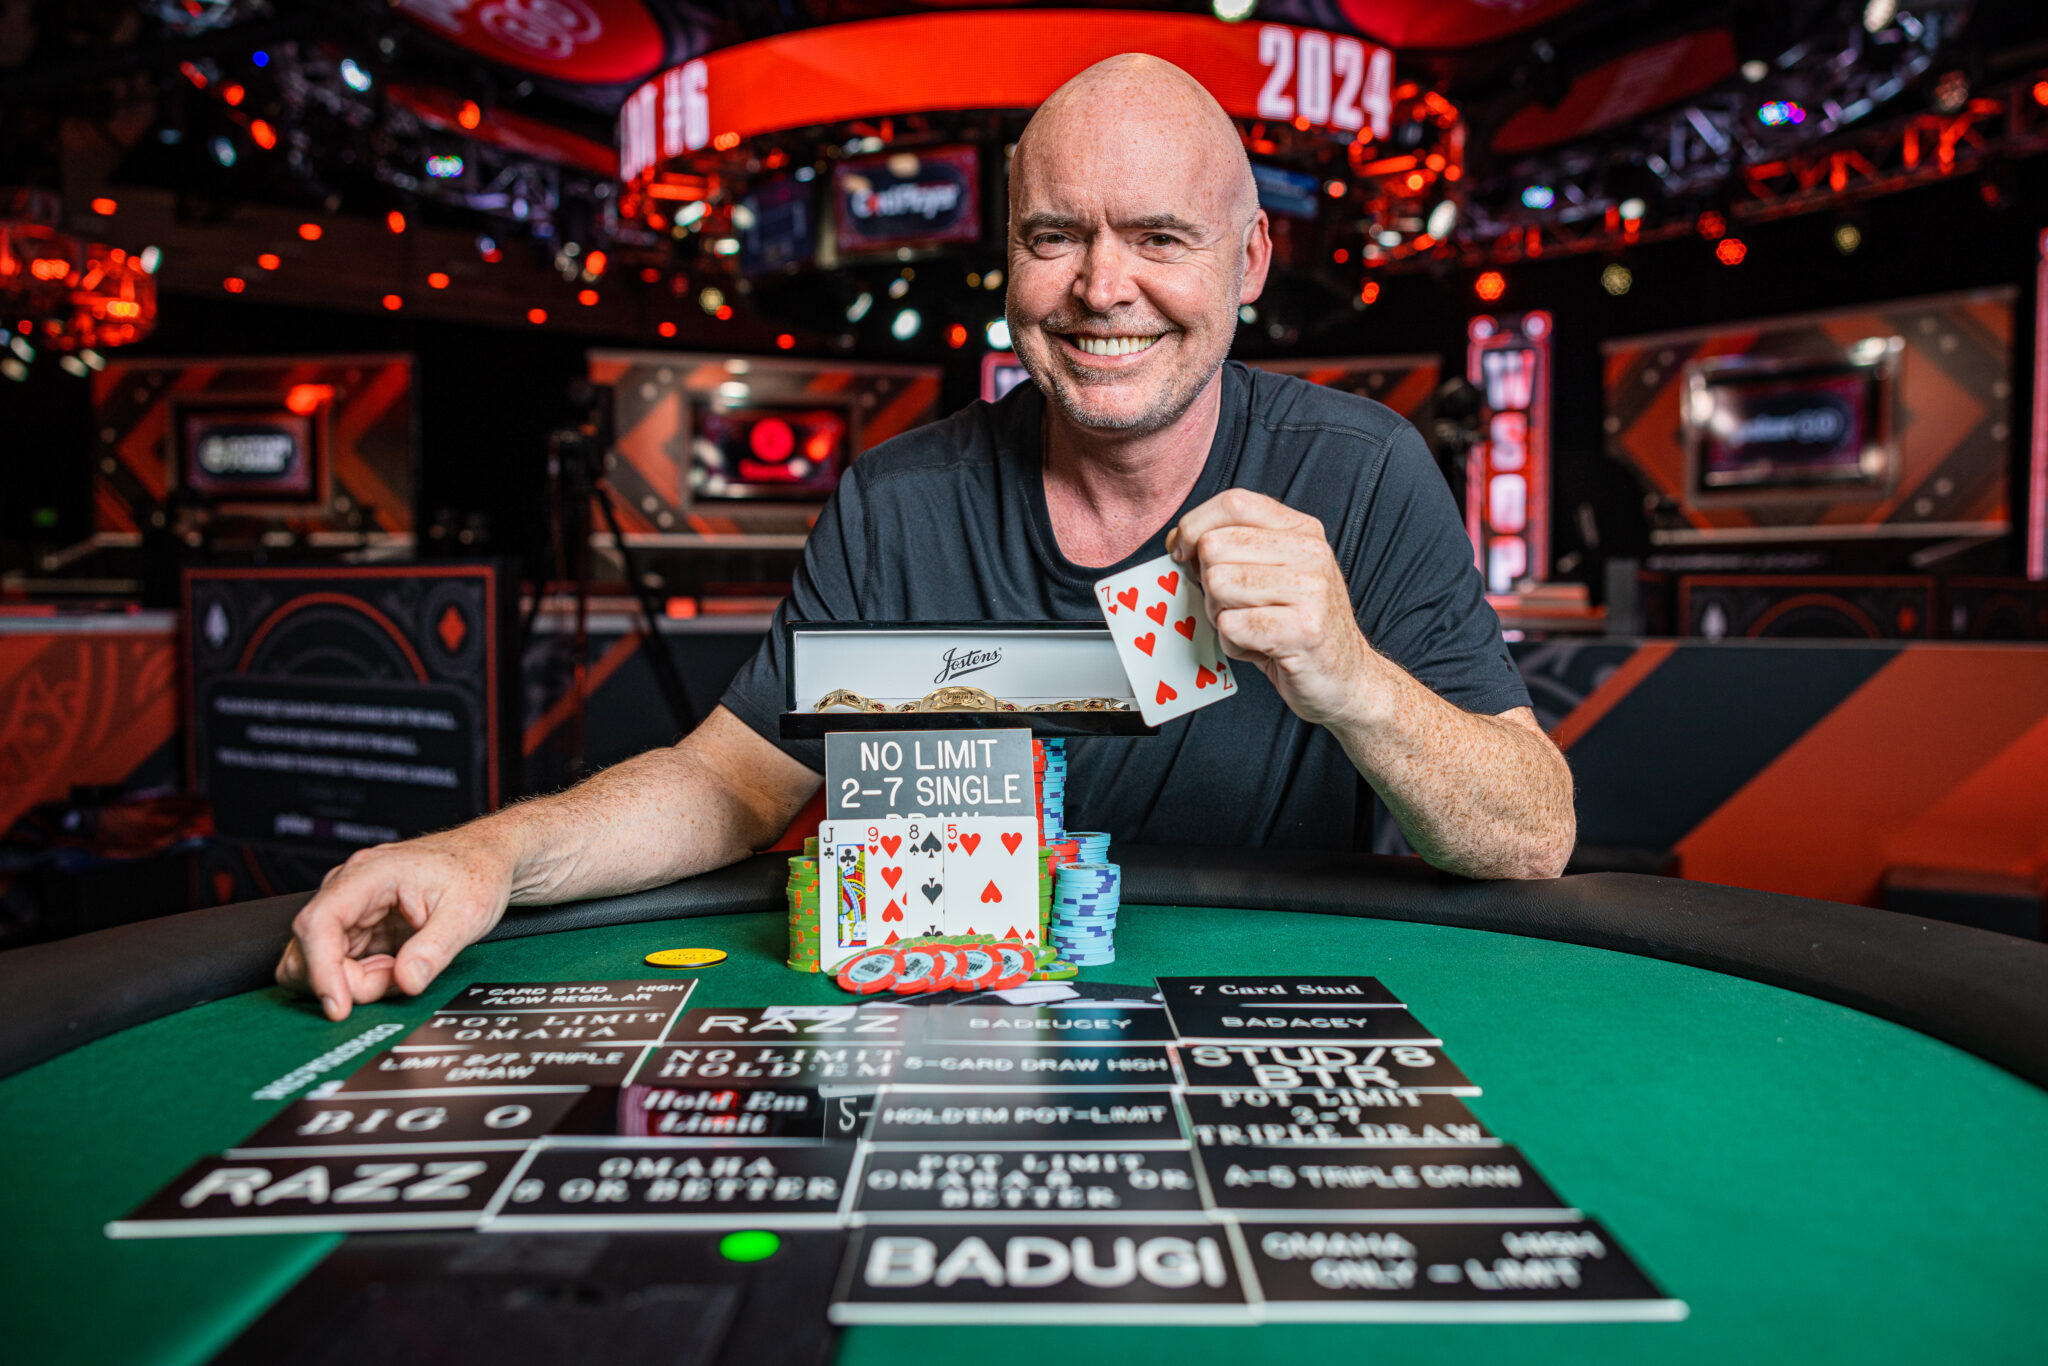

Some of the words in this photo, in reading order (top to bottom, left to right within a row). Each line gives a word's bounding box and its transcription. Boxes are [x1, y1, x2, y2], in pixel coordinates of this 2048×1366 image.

[1257, 24, 1392, 139] 2024
[663, 58, 709, 157] #6
[1483, 349, 1535, 594] WSOP
[1100, 586, 1111, 603] 7
[934, 647, 1003, 685] Jostens
[1223, 673, 1233, 691] 7
[861, 741, 903, 771] NO
[915, 739, 998, 770] LIMIT
[841, 776, 903, 808] 2-7
[916, 774, 1021, 806] SINGLE
[823, 827, 834, 843] J
[868, 827, 879, 842] 9
[909, 824, 920, 839] 8
[947, 824, 958, 839] 5
[481, 996, 546, 1005] /LOW
[549, 994, 653, 1004] REGULAR
[488, 988, 547, 996] CARD
[552, 986, 608, 995] STUD
[1189, 985, 1206, 995] 7
[1218, 984, 1288, 995] Card
[1296, 984, 1364, 995] Stud
[430, 1016, 518, 1028] POT
[542, 1012, 666, 1026] LIMIT
[698, 1015, 899, 1034] RAZZ
[454, 1027, 616, 1041] OMAHA
[379, 1055, 460, 1071] LIMIT
[529, 1052, 625, 1065] TRIPLE
[668, 1049, 737, 1063] NO
[756, 1049, 901, 1063] LIMIT
[904, 1056, 1014, 1071] 5-CARD
[1020, 1058, 1100, 1071] DRAW
[1107, 1058, 1169, 1071] HIGH
[1191, 1046, 1436, 1067] STUD/8
[445, 1065, 536, 1081] DRAW
[658, 1062, 892, 1078] HOLD'EM
[1253, 1064, 1400, 1089] BTR
[1219, 1088, 1292, 1107] POT
[1314, 1087, 1421, 1107] LIMIT
[296, 1107, 448, 1136] BIG
[484, 1104, 532, 1129] O
[1014, 1106, 1167, 1124] POT-LIMIT
[1291, 1106, 1360, 1125] 2-7
[1193, 1124, 1341, 1145] TRIPLE
[1357, 1123, 1481, 1142] DRAW
[599, 1156, 777, 1179] OMAHA
[919, 1154, 1003, 1173] POT
[1022, 1153, 1144, 1173] LIMIT
[179, 1160, 488, 1208] RAZZ
[867, 1169, 1031, 1191] OMAHA
[1128, 1168, 1194, 1190] OR
[1225, 1164, 1296, 1188] A-5
[1299, 1165, 1420, 1188] TRIPLE
[1420, 1165, 1522, 1188] DRAW
[558, 1178, 630, 1203] OR
[645, 1176, 840, 1201] BETTER
[942, 1186, 1121, 1208] BETTER
[1261, 1231, 1418, 1260] OMAHA
[1501, 1230, 1606, 1259] HIGH
[864, 1236, 1227, 1288] BADUGI
[1464, 1257, 1581, 1290] LIMIT
